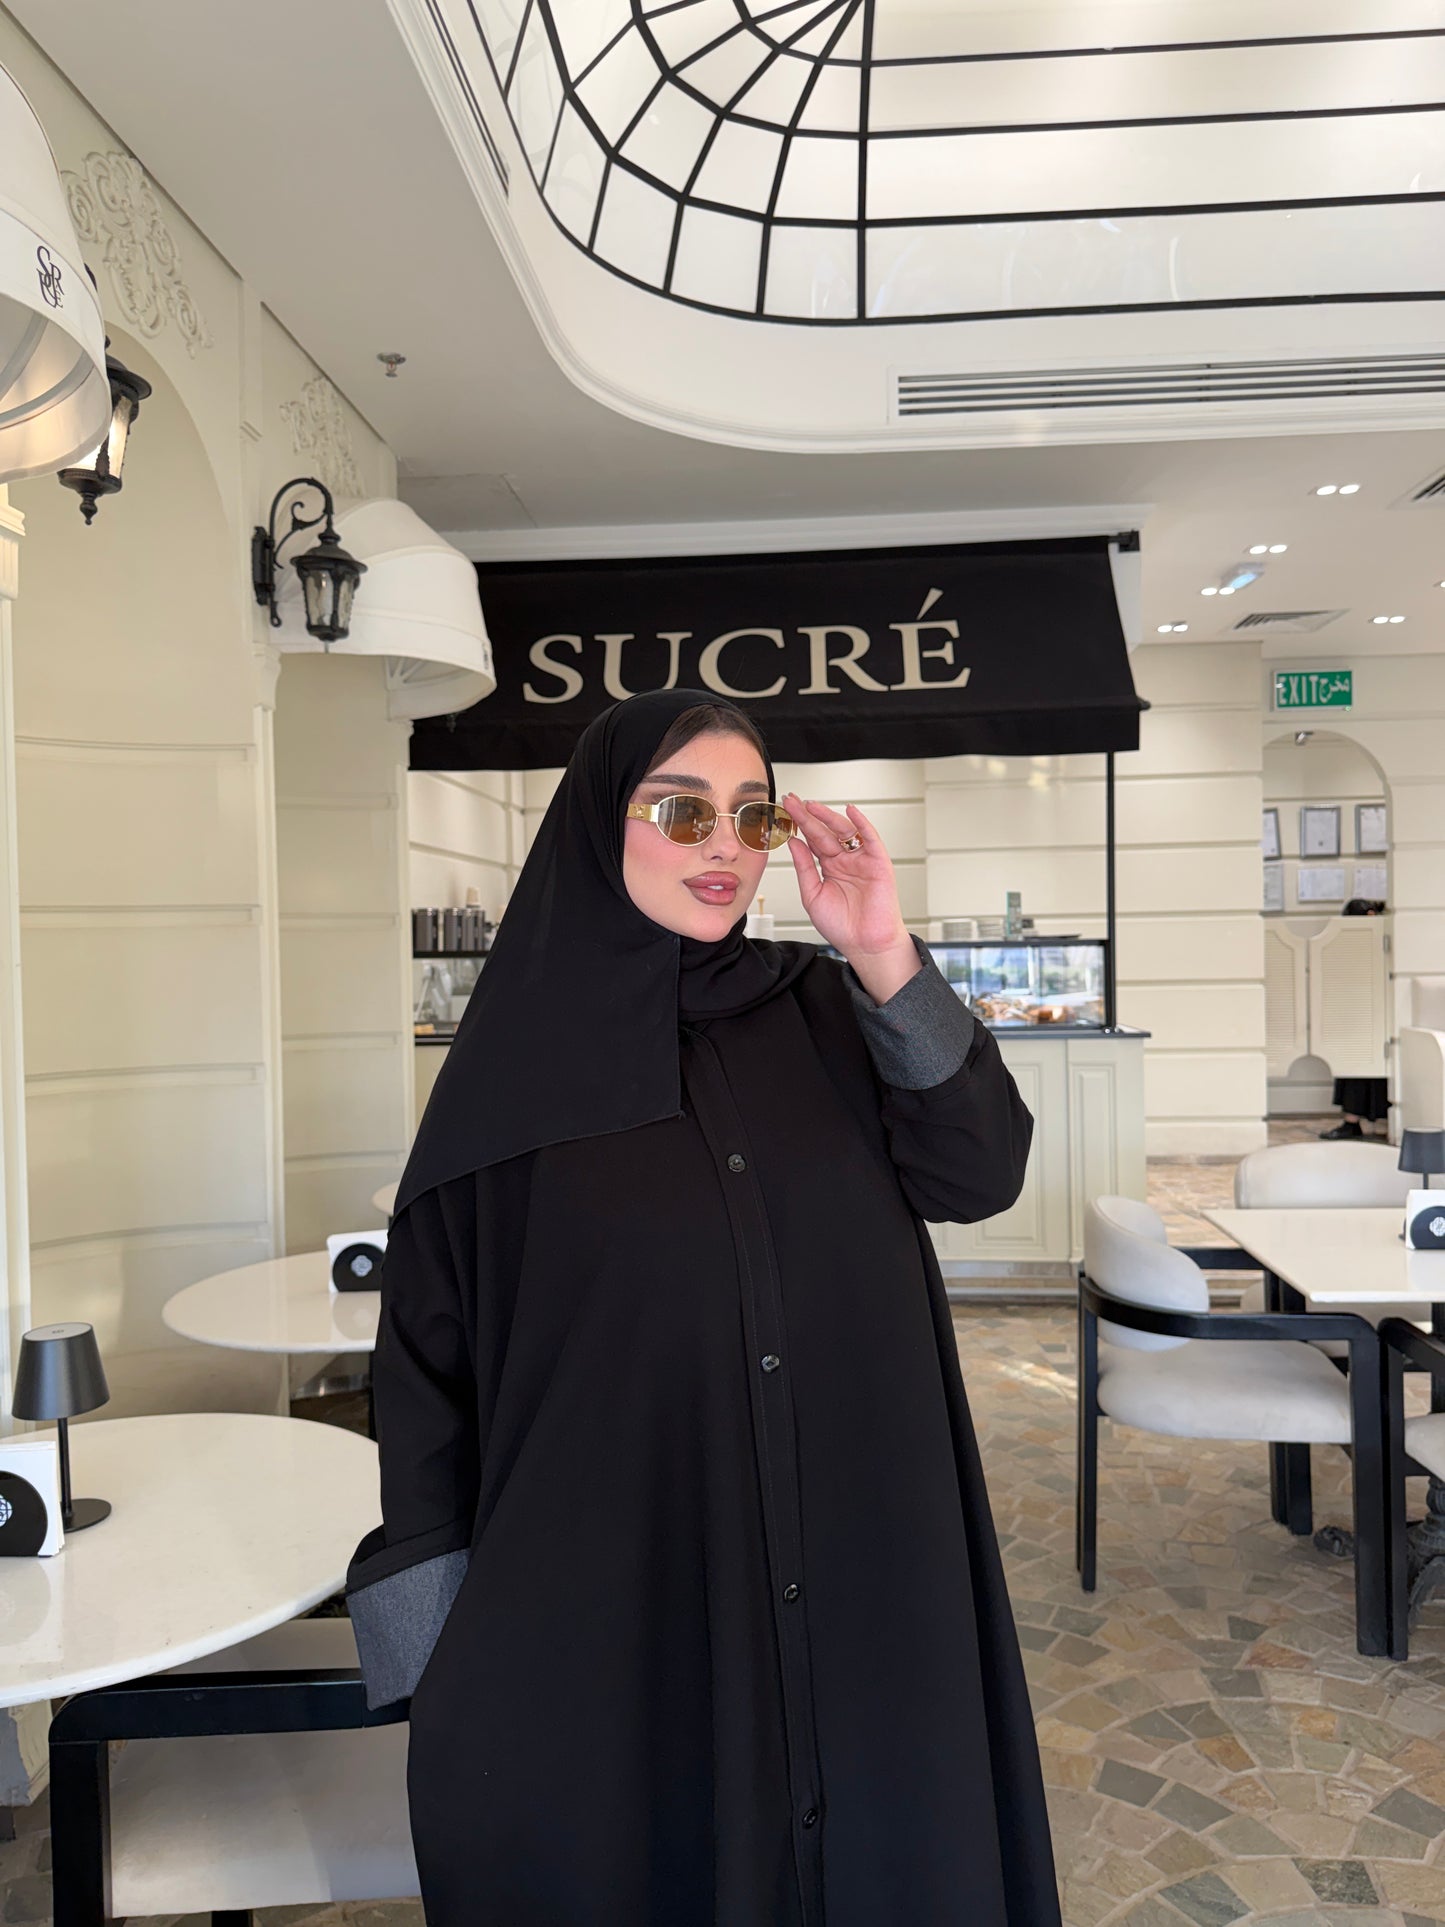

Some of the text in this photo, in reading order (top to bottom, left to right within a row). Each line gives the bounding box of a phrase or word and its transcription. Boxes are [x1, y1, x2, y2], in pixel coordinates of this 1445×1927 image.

[522, 587, 972, 704] SUCRÉ
[1279, 675, 1319, 705] EXIT
[1319, 675, 1350, 703] مخرج
